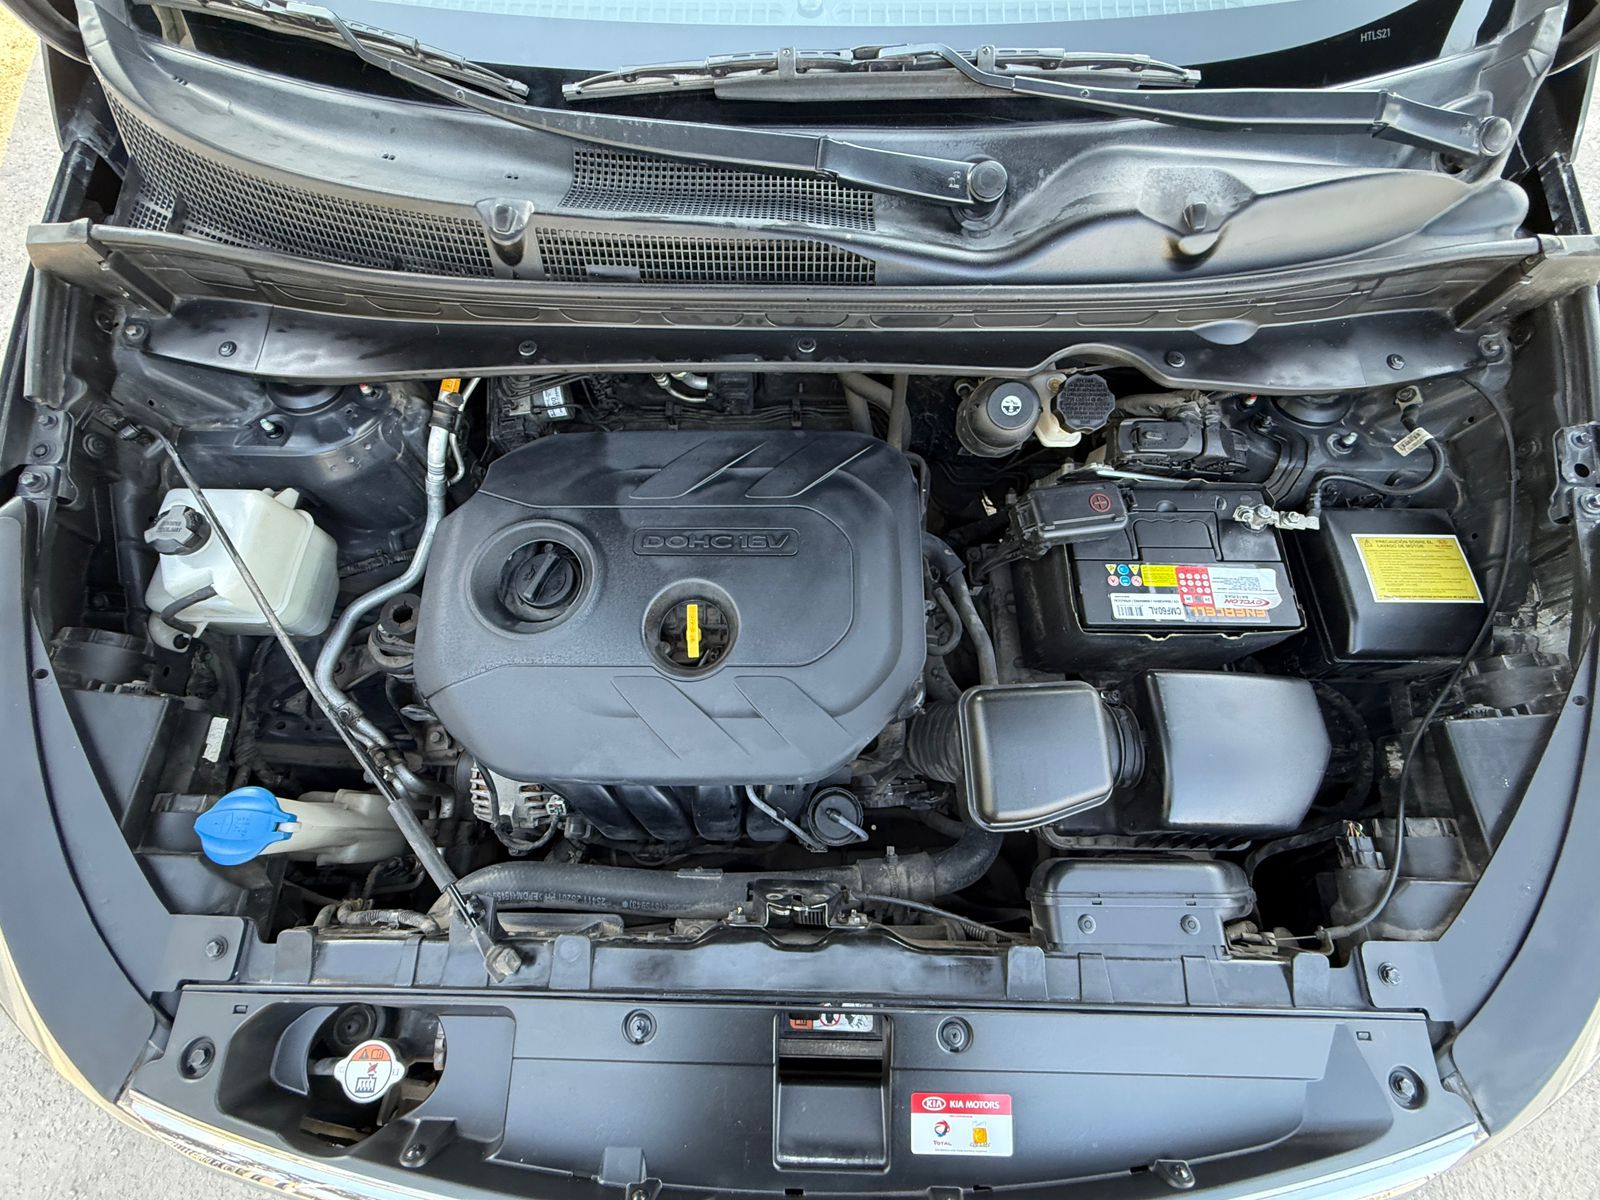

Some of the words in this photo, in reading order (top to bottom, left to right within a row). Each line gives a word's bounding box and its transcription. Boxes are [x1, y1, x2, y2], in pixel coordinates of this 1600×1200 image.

[1360, 28, 1391, 42] HTLS21
[642, 534, 732, 549] DOHC
[739, 534, 789, 549] 16V
[1224, 597, 1264, 605] CYCLON
[1147, 606, 1182, 616] CMF60AL
[926, 1099, 942, 1108] KIA
[949, 1099, 965, 1109] KIA
[965, 1100, 1000, 1110] MOTORS
